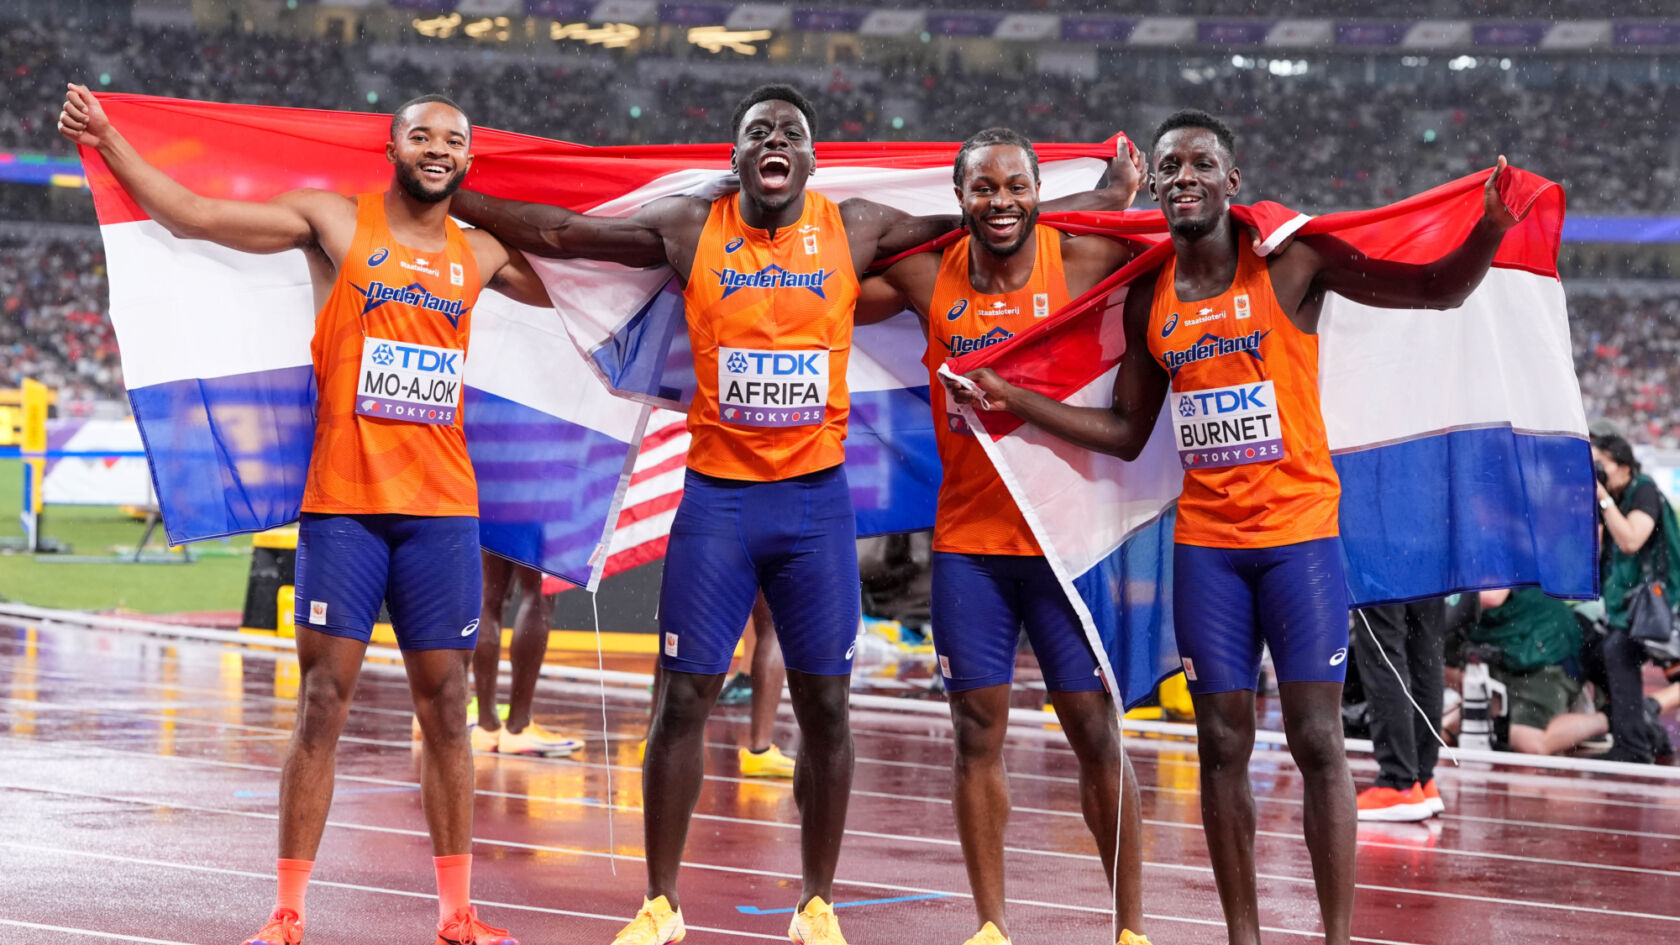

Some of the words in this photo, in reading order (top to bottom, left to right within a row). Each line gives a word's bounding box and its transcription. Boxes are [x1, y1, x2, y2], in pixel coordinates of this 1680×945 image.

[978, 307, 1020, 316] Staatsloterij
[1184, 311, 1226, 326] Staatsloterij
[395, 345, 458, 375] TDK
[748, 353, 820, 375] TDK
[364, 370, 457, 403] MO-AJOK
[726, 381, 820, 405] AFRIFA
[1193, 385, 1267, 415] TDK
[1180, 414, 1272, 447] BURNET
